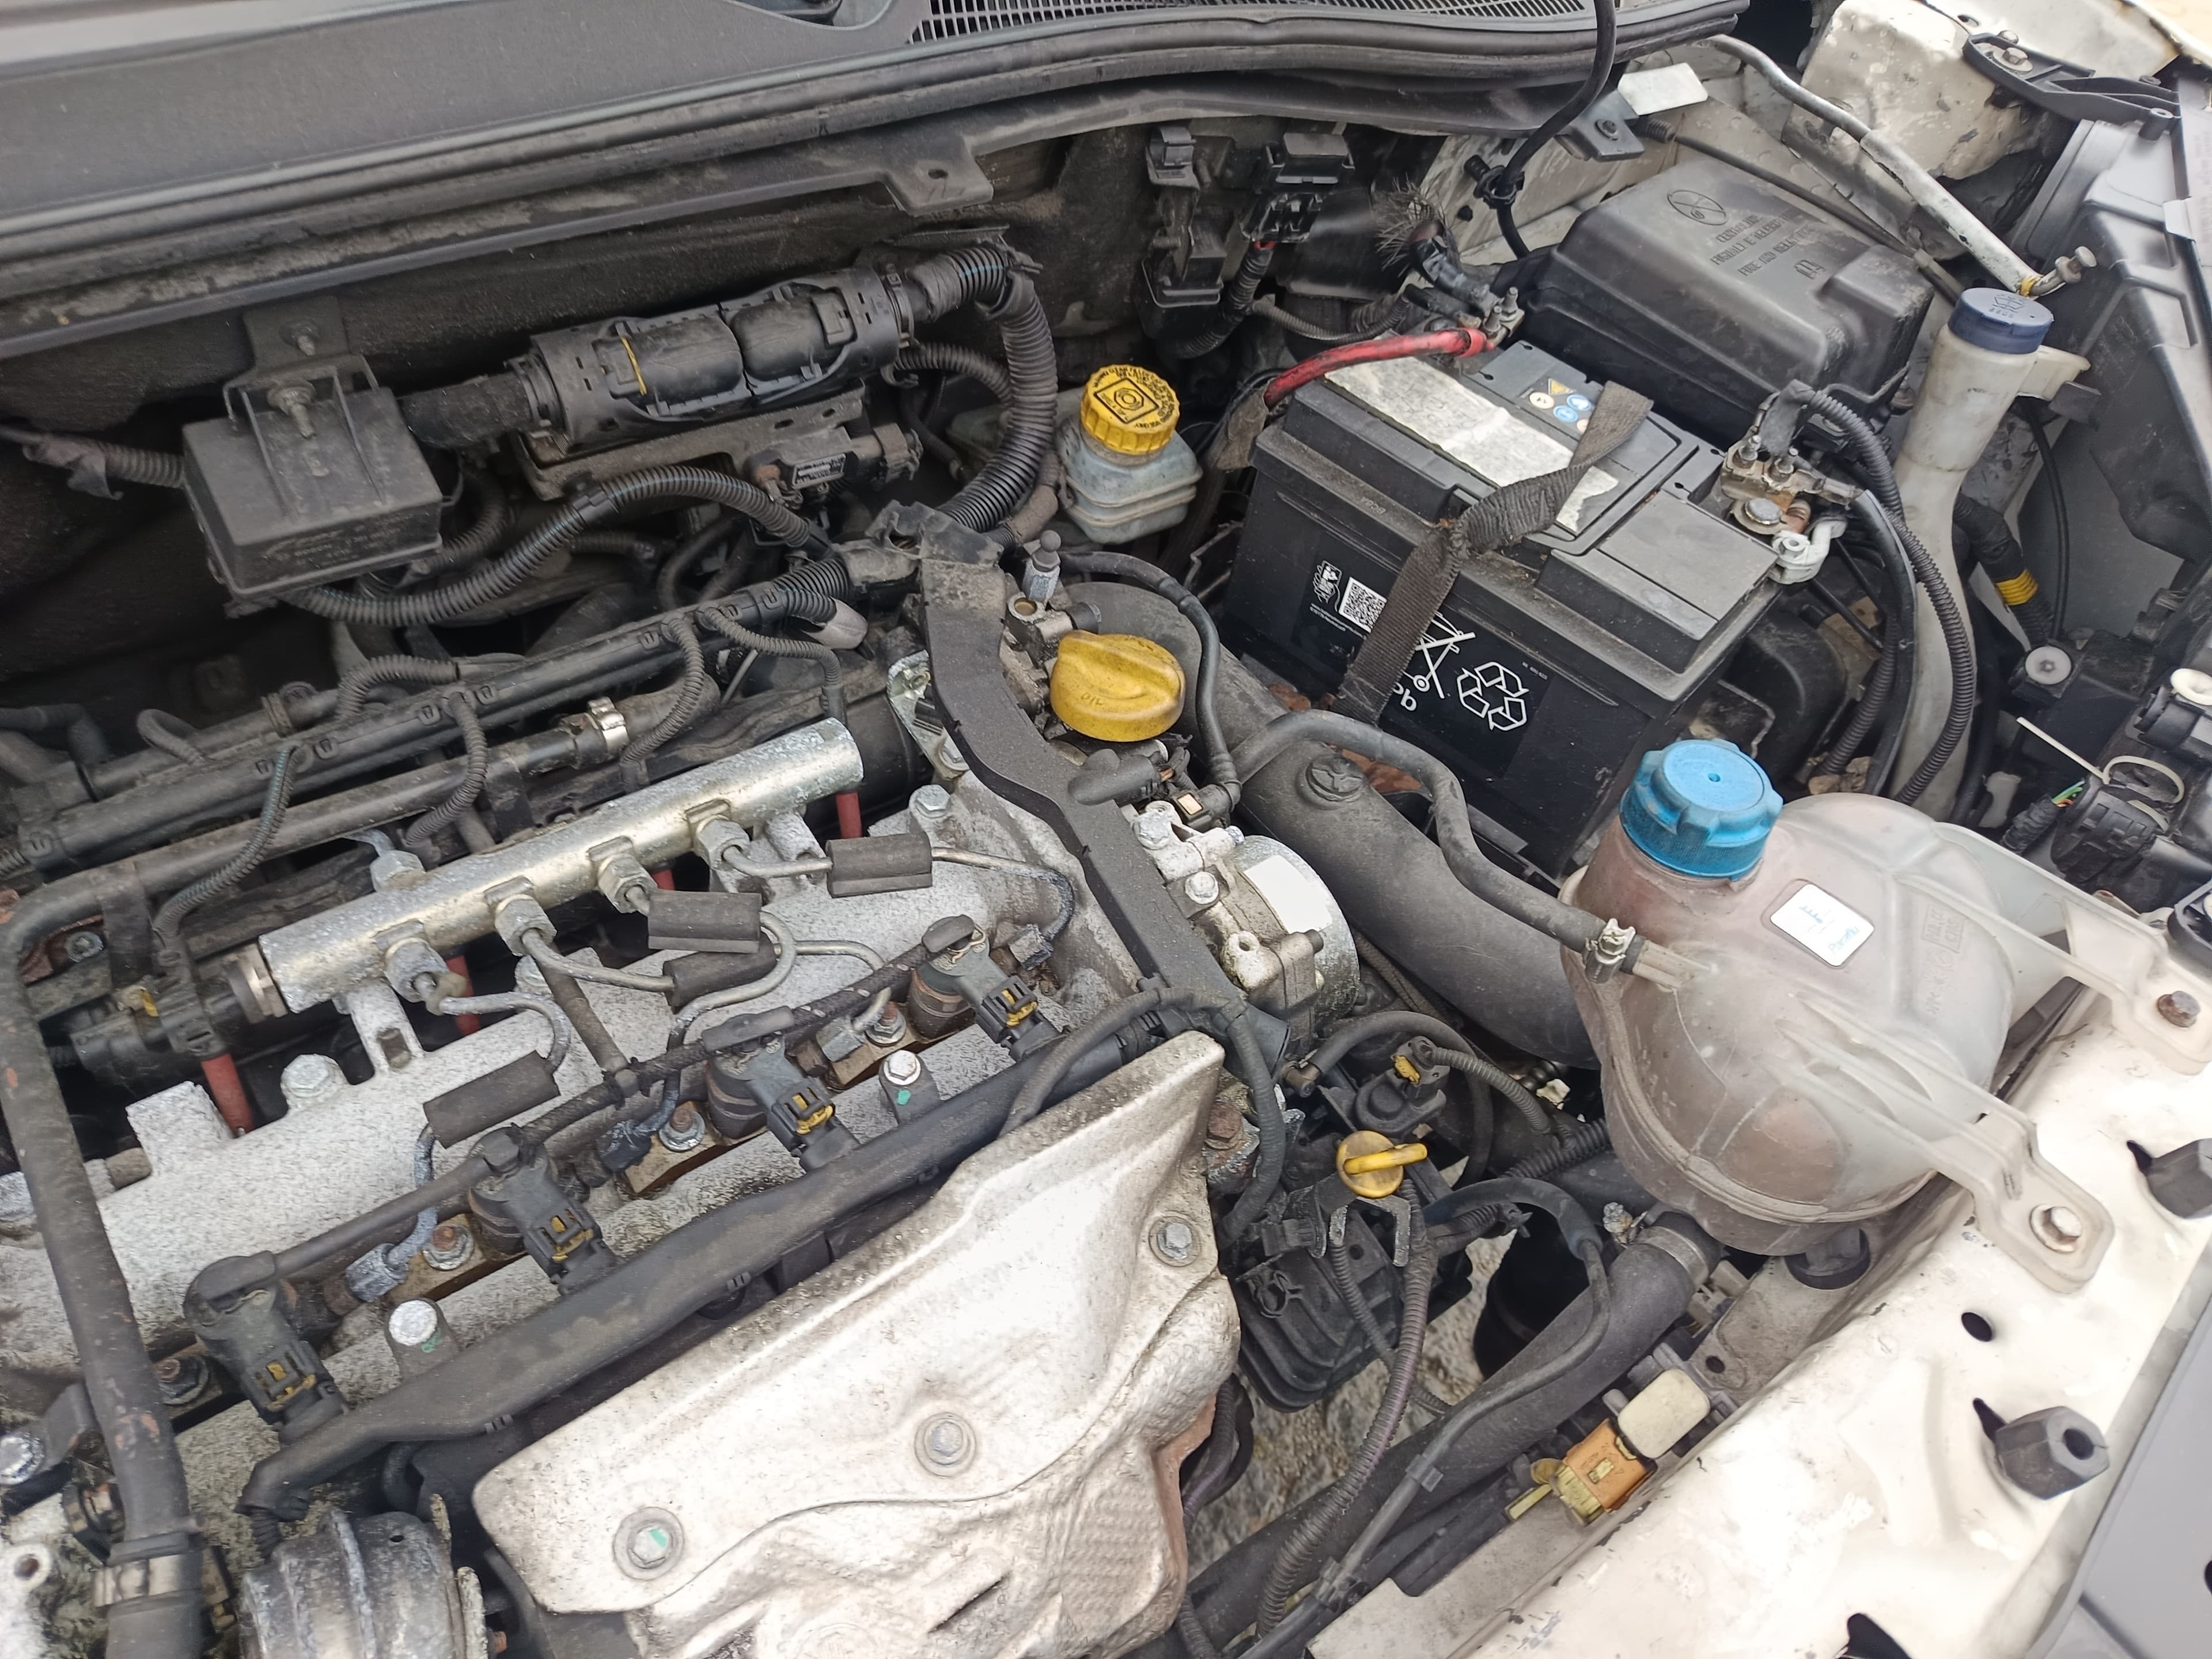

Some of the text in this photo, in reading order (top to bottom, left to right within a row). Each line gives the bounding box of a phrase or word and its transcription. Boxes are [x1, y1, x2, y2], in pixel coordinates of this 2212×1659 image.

[1737, 261, 1763, 276] FUSE
[1758, 251, 1777, 264] AND
[1080, 692, 1101, 705] OIL
